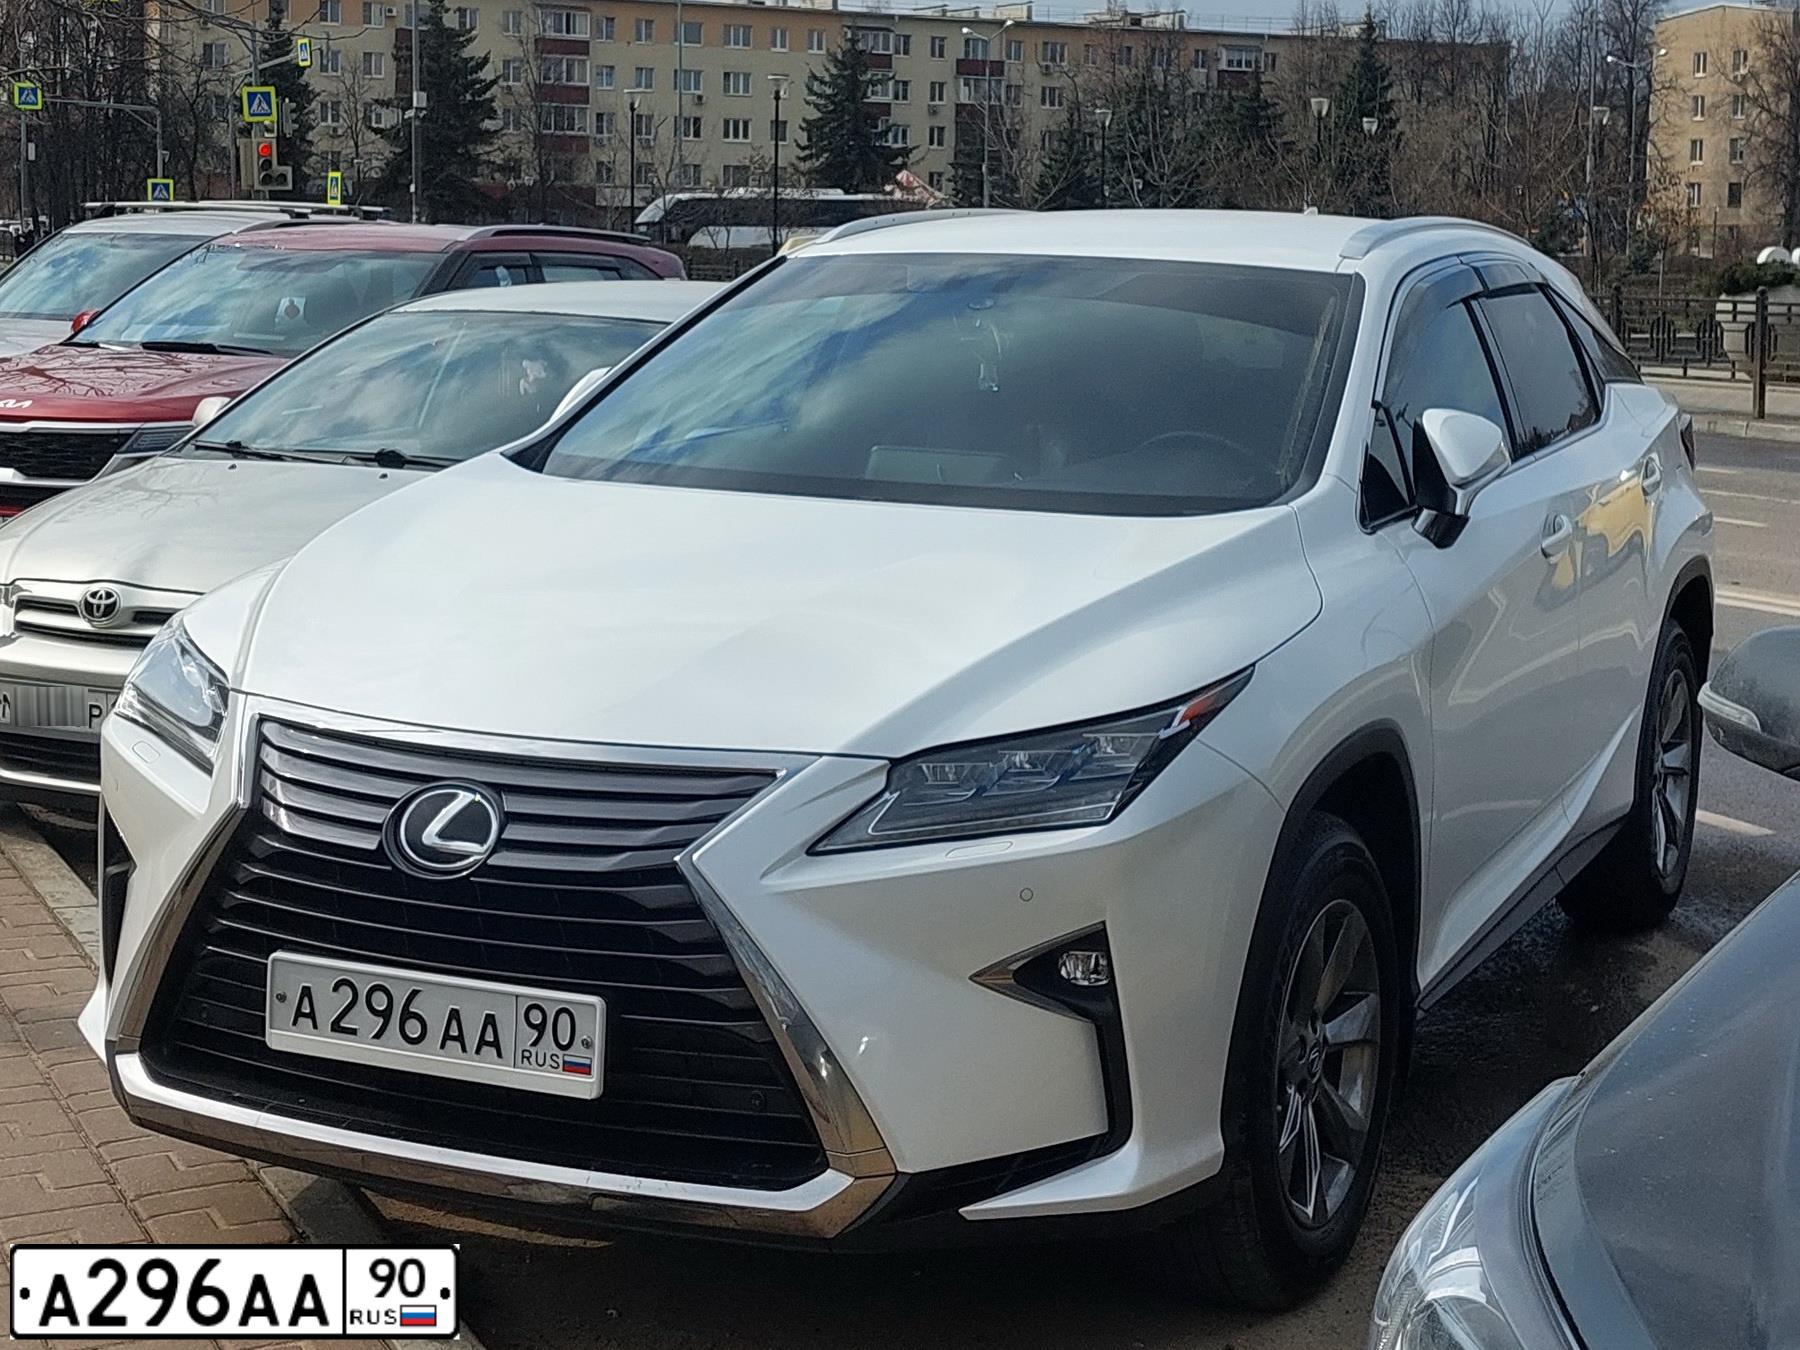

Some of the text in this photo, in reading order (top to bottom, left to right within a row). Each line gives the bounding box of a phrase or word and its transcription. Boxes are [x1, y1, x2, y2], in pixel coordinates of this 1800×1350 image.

[291, 977, 577, 1060] А296АА 90
[520, 1048, 561, 1070] RUS
